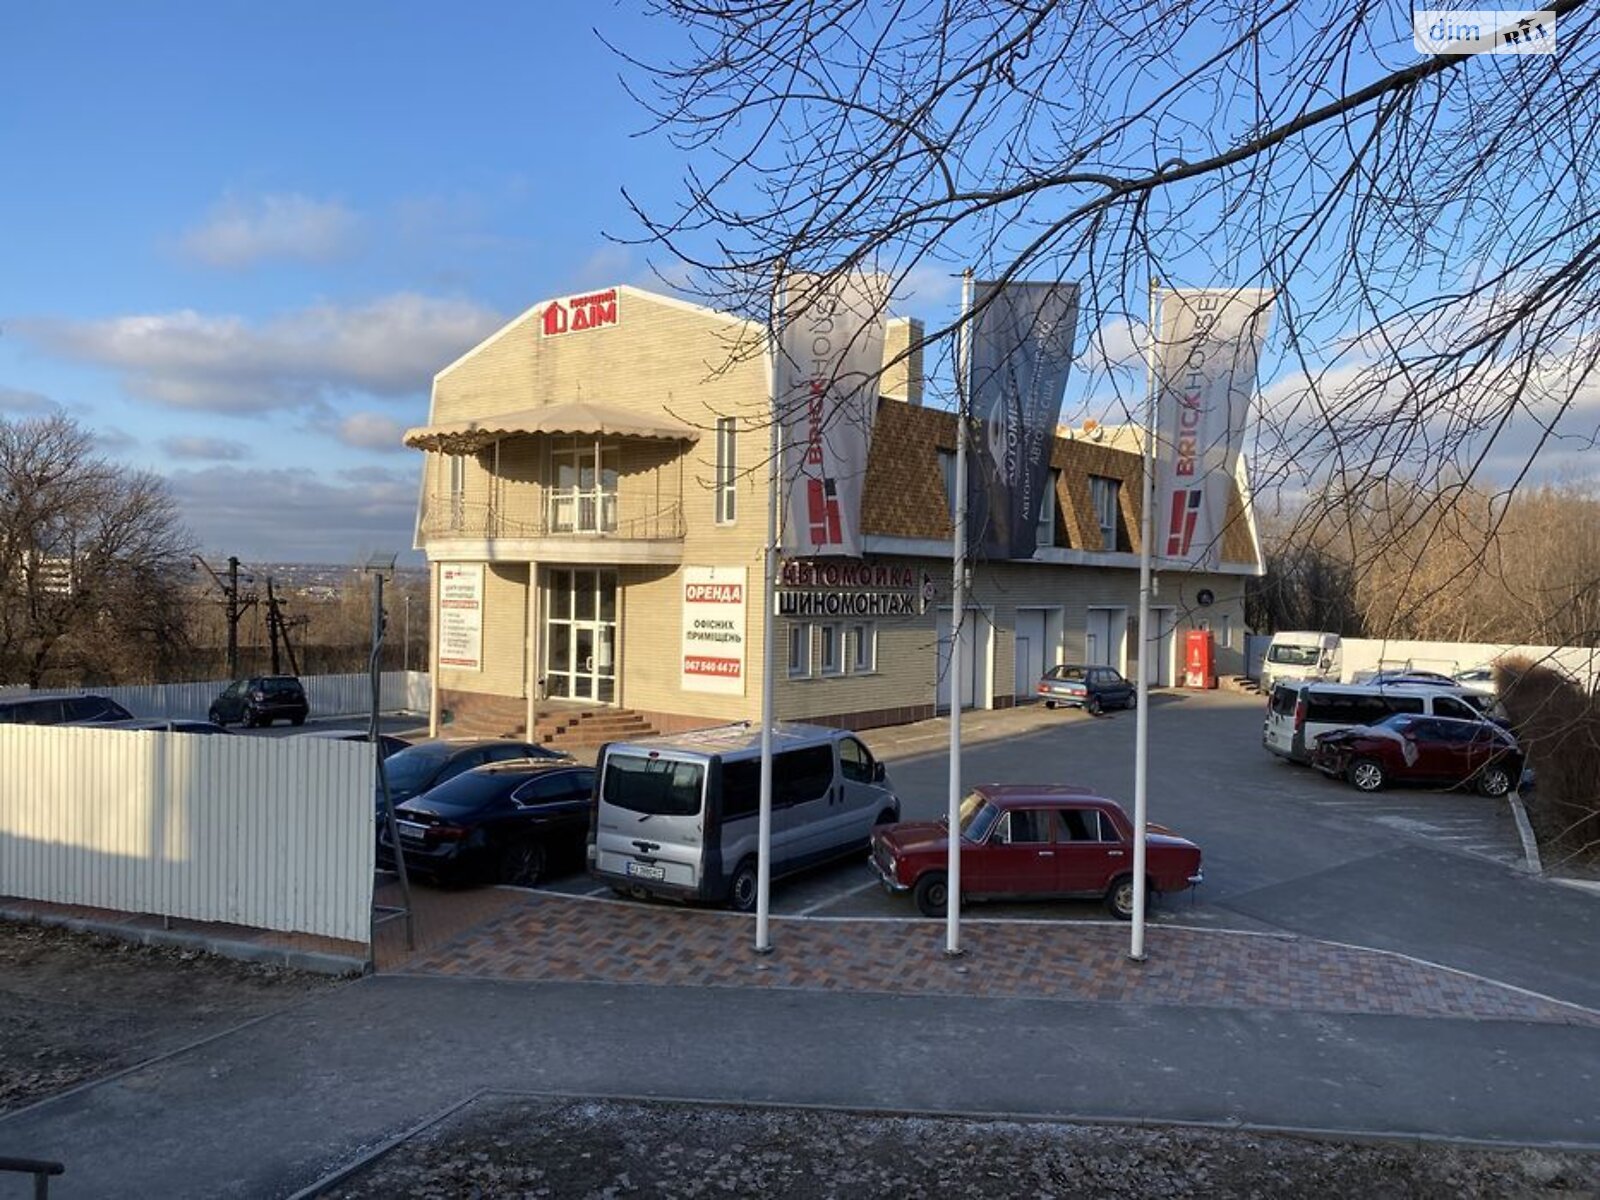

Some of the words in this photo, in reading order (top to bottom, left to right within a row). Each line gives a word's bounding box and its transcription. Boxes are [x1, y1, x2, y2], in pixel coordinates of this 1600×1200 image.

[687, 585, 741, 603] ОРЕНДА
[775, 591, 914, 615] ШИНОМОНТАЖ
[694, 619, 734, 629] ОФІСНИХ
[686, 630, 741, 642] ПРИМІЩЕНЬ
